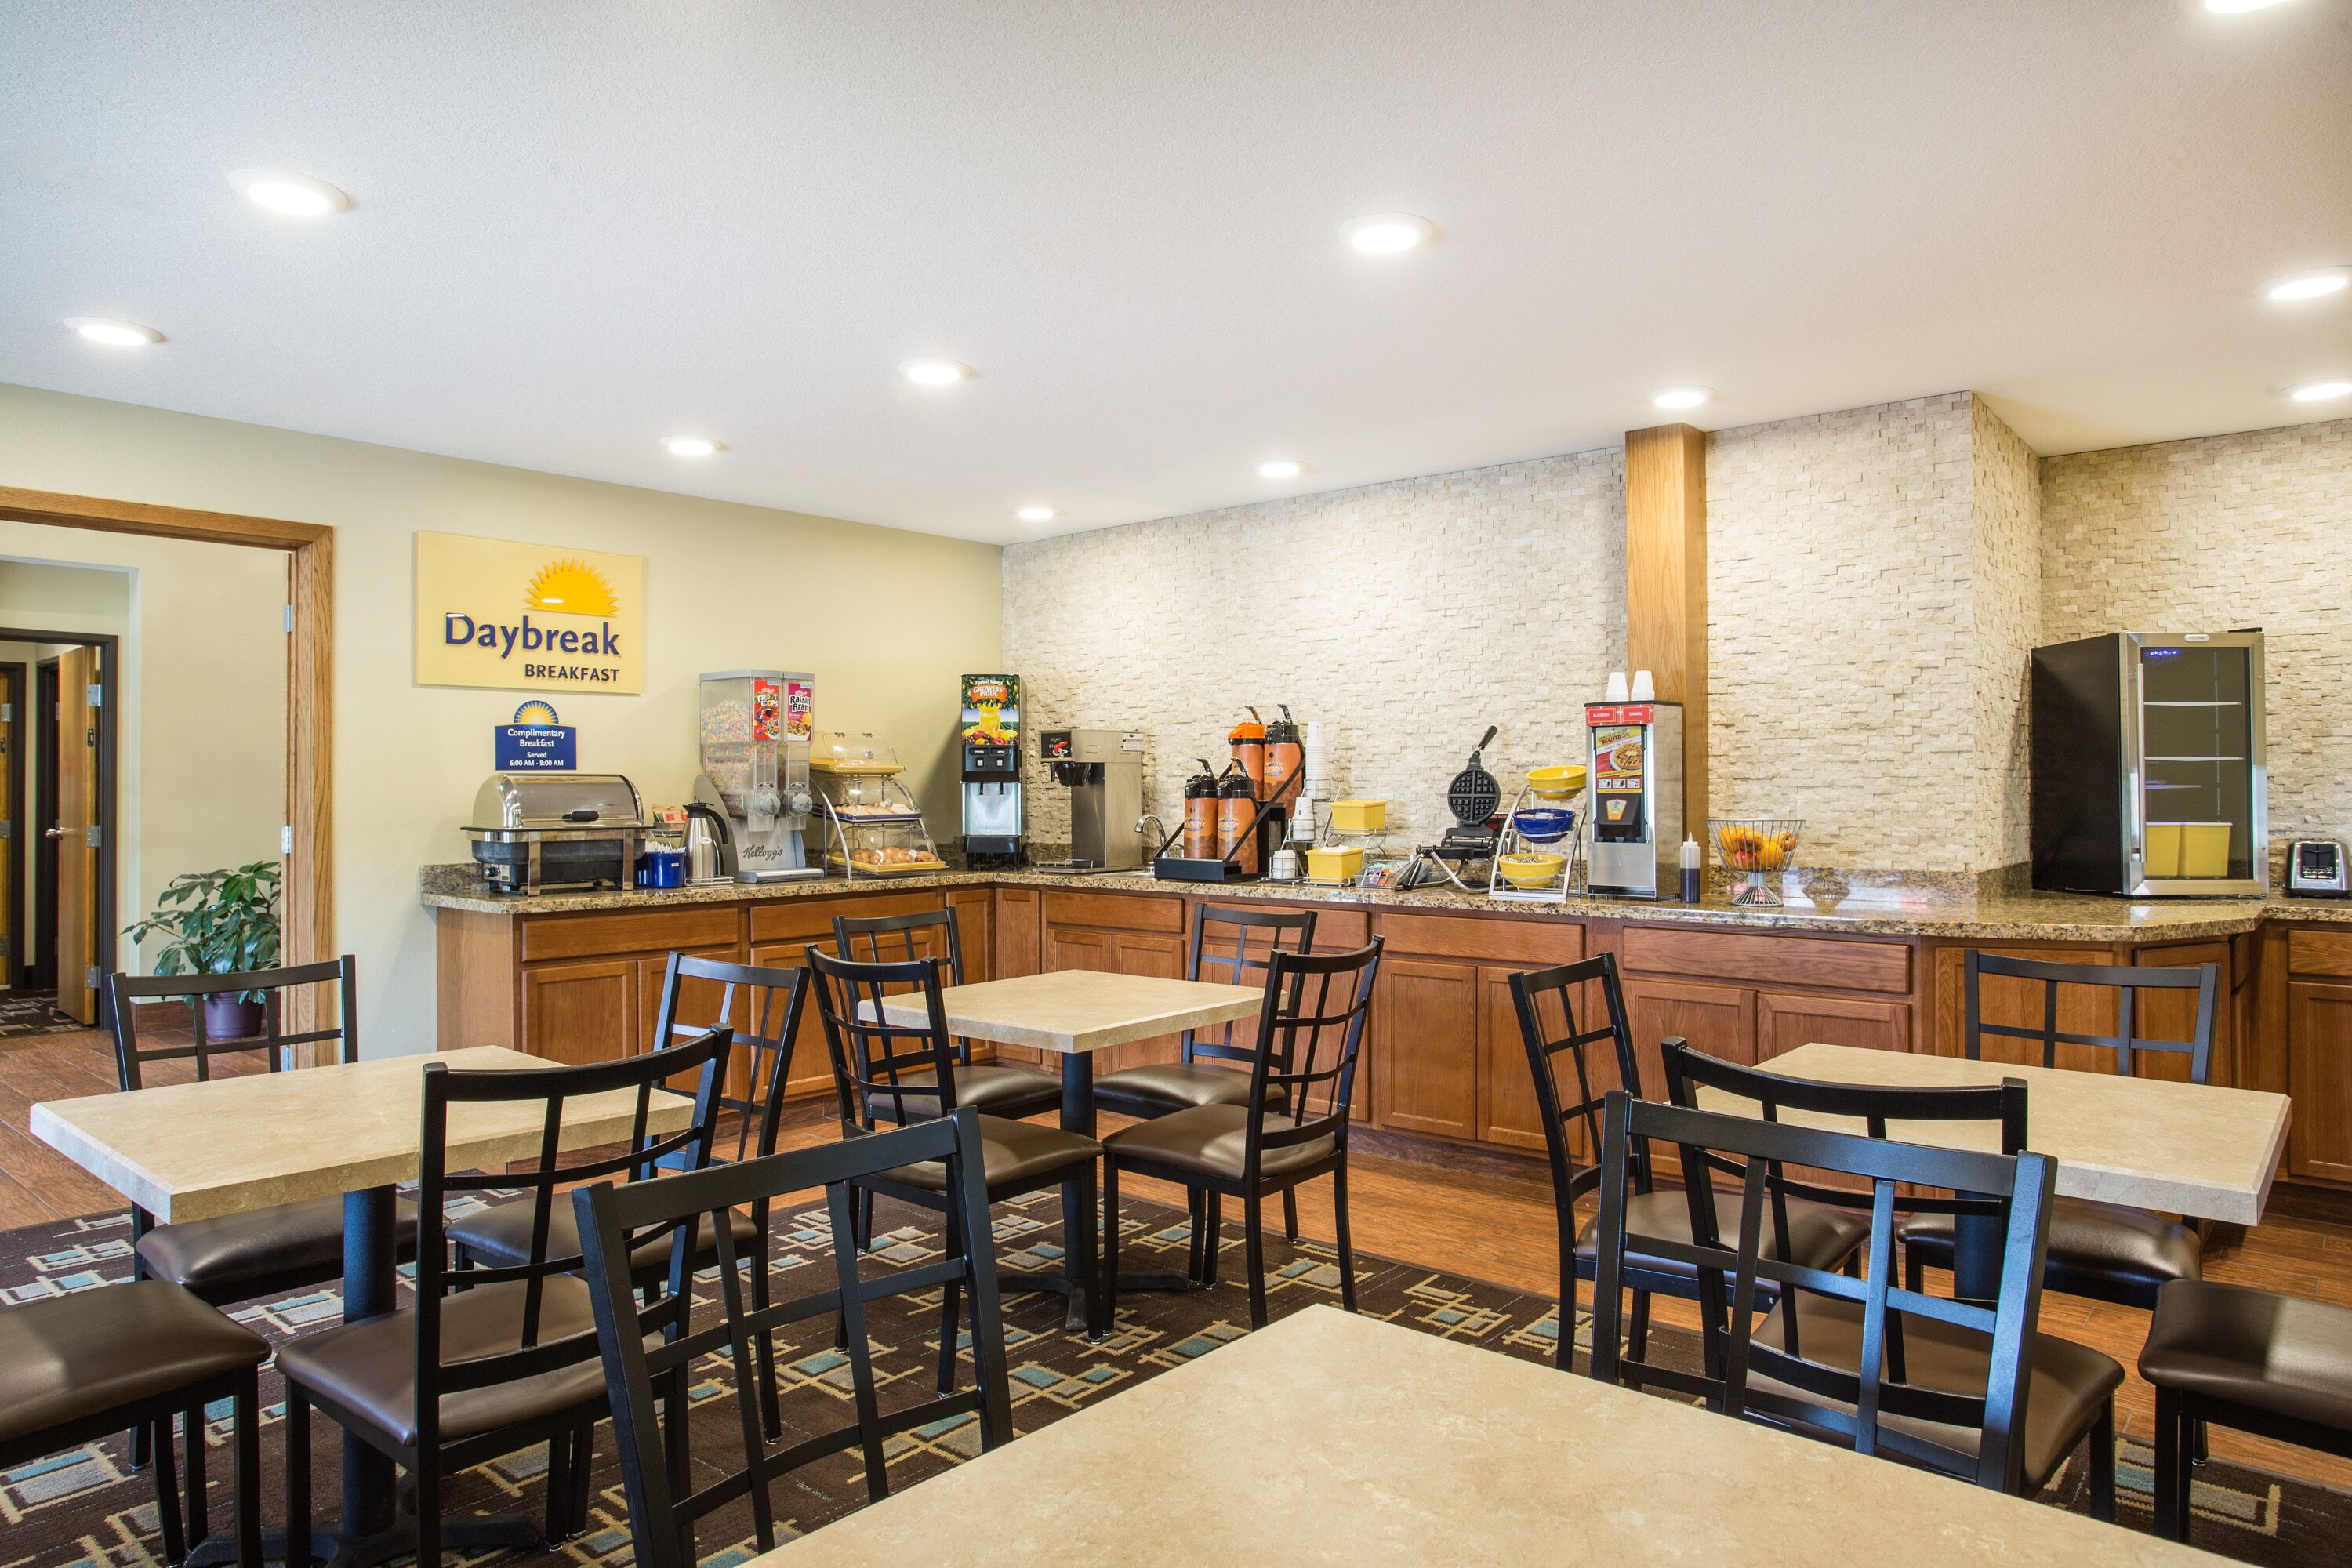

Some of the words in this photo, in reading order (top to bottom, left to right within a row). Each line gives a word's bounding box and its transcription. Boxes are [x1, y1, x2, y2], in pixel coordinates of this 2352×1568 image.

[445, 612, 619, 659] Daybreak
[525, 664, 619, 681] BREAKFAST
[789, 695, 811, 706] Raisin
[507, 728, 565, 739] Complimentary
[742, 844, 783, 861] Kellogg's
